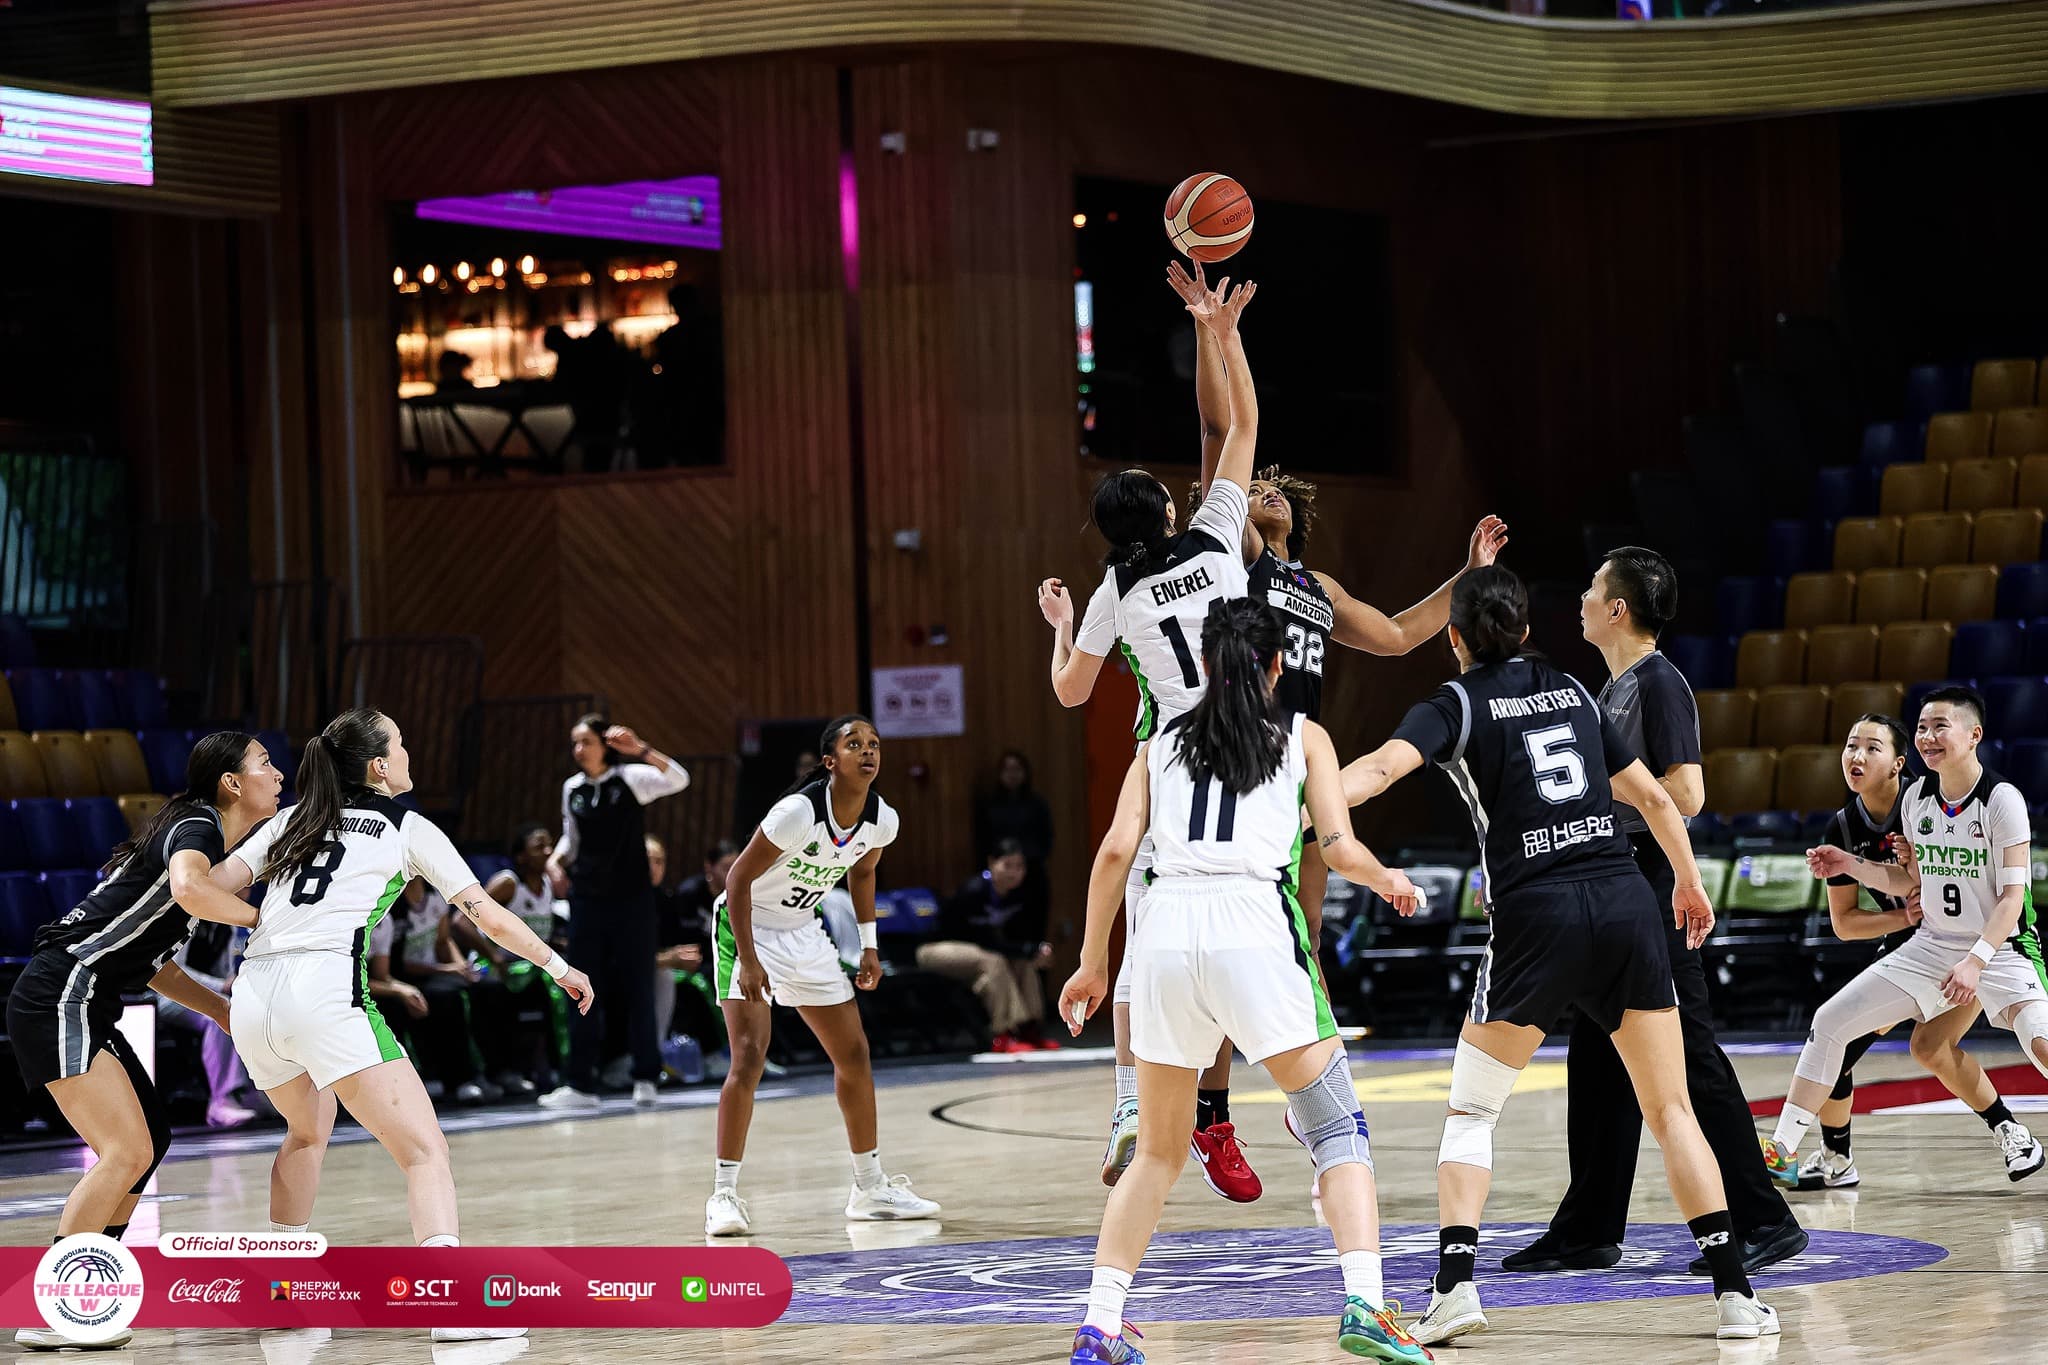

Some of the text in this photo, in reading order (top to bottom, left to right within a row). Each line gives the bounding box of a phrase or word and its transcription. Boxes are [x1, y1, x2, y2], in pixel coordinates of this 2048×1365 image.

[1150, 566, 1214, 606] ENEREL
[1285, 596, 1331, 628] AMAZONS
[1283, 622, 1326, 677] 32
[1488, 687, 1582, 720] ARIUNTSETSEG
[1522, 722, 1589, 805] 5
[289, 841, 346, 907] 8
[781, 886, 824, 910] 30
[1943, 884, 1961, 916] 9
